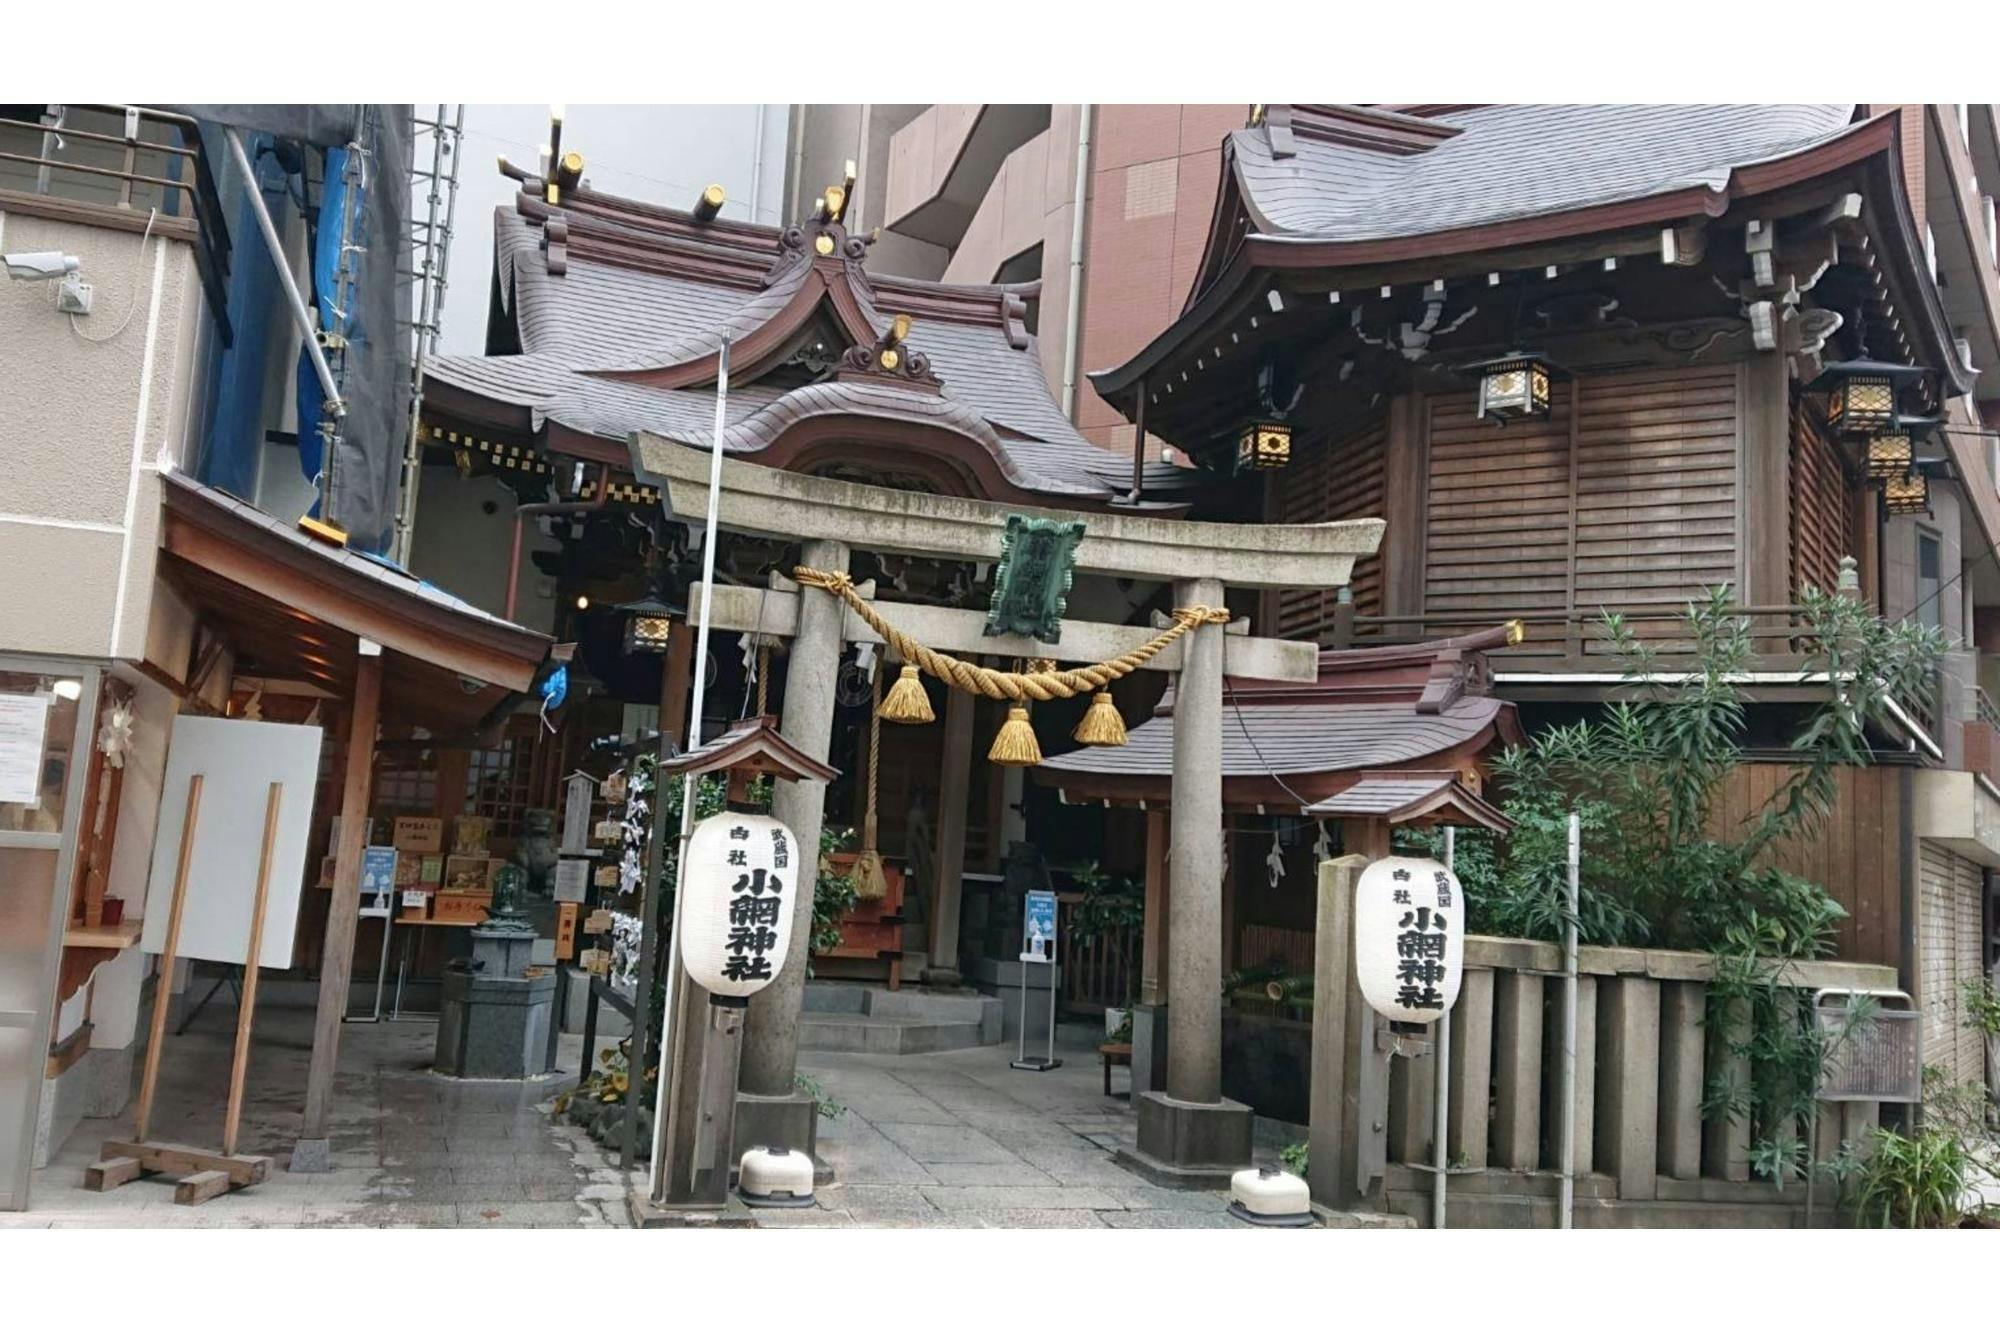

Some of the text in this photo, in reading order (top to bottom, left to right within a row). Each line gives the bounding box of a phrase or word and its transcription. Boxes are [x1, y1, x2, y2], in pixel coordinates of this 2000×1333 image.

[721, 868, 783, 982] 小網神社
[1395, 906, 1448, 1010] 小網神社
